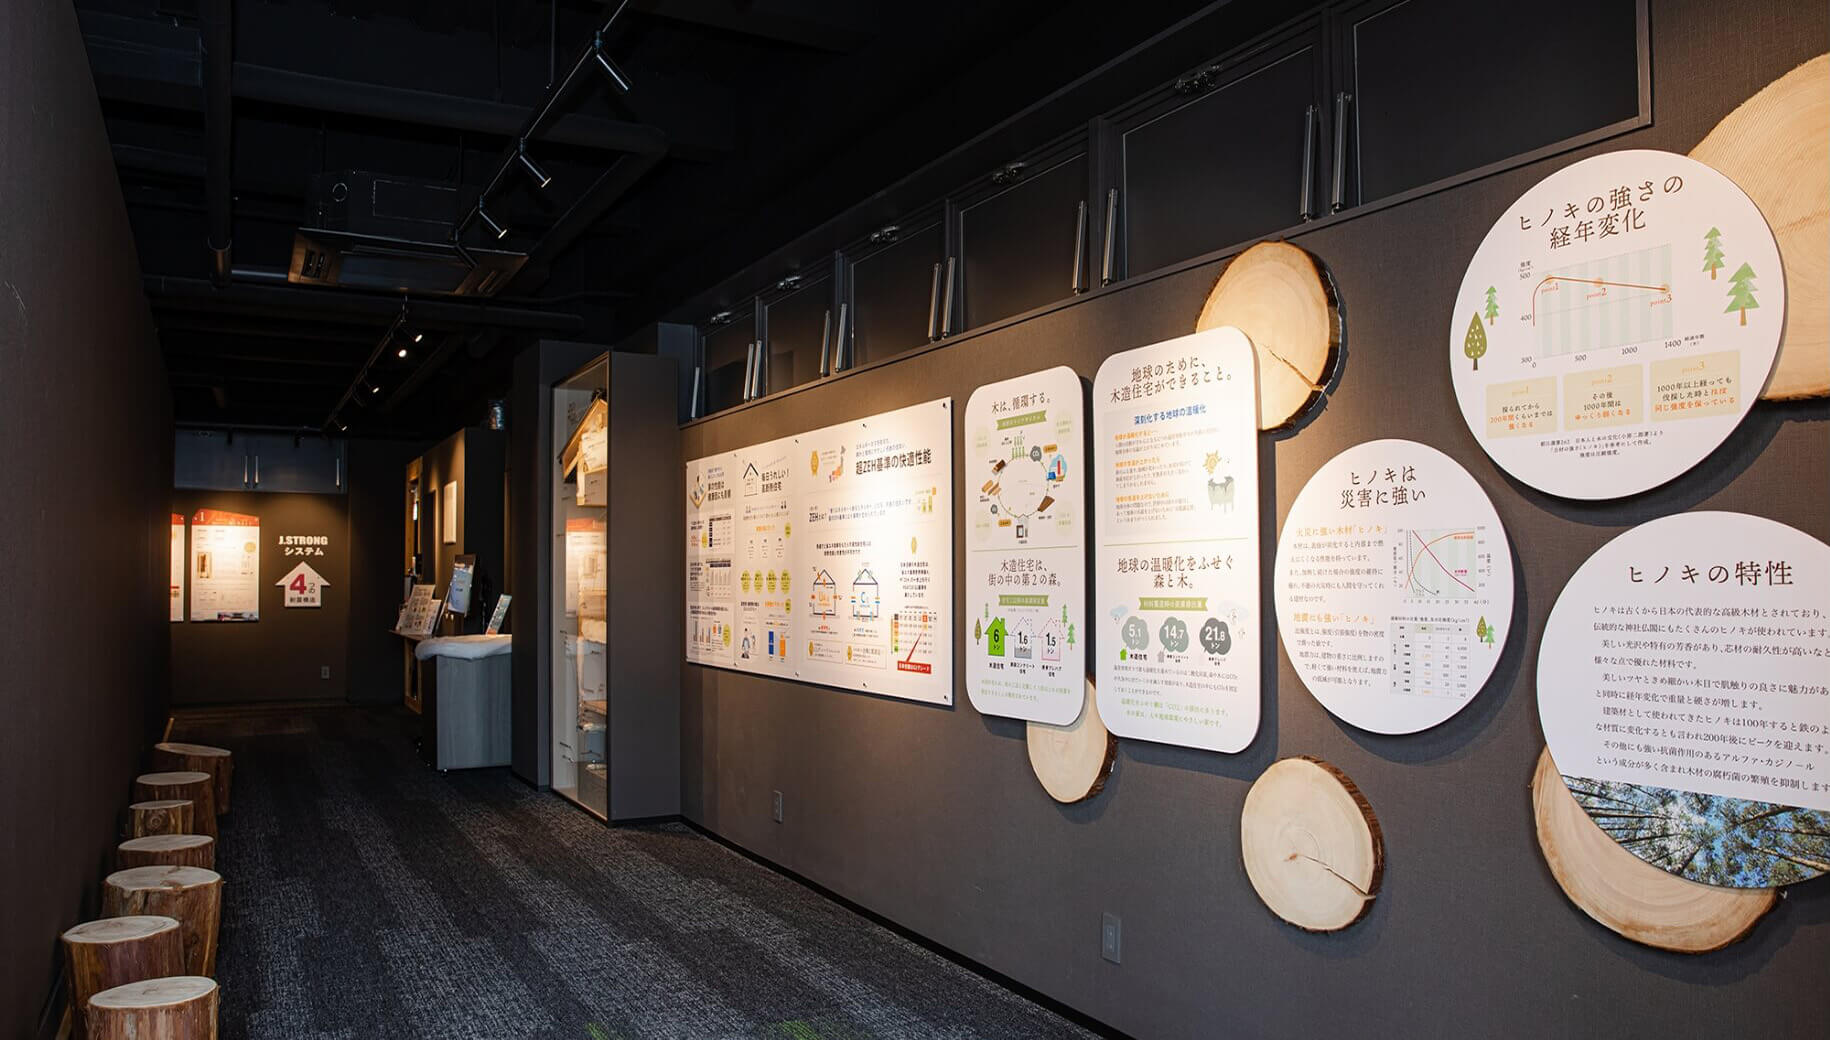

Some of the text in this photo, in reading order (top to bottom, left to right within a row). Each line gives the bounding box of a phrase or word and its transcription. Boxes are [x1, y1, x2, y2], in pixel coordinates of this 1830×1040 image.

[1519, 174, 1685, 230] ヒノキの強さの
[1549, 207, 1647, 250] 経年変化
[1520, 313, 1532, 321] 400
[1621, 346, 1638, 355] 1000
[1664, 339, 1682, 348] 1400
[1575, 354, 1587, 362] 500
[1130, 355, 1207, 383] 地球のために、
[1110, 367, 1232, 403] 木造住宅ができること。
[1657, 376, 1732, 392] 1000年以上経っても
[991, 392, 1051, 414] 木は、循環する。
[855, 448, 932, 475] 超ZEH基準の快適性能
[1350, 466, 1417, 486] ヒノキは
[1340, 485, 1426, 509] 災害に強い
[279, 535, 328, 545] J.STRONG
[284, 547, 324, 556] システム
[1000, 558, 1048, 573] 木造住宅は、
[1117, 555, 1233, 574] 地球の温暖化をふせぐ
[988, 573, 1061, 587] 街の中の第2の森。
[1629, 560, 1794, 587] ヒノキの特性
[289, 573, 307, 595] 4
[1153, 574, 1194, 590] 森と木。
[1593, 606, 1827, 619] ヒノキは古くから日本の代表的な高級木材とされており、
[993, 628, 1000, 643] 6
[1128, 623, 1142, 637] 5.1
[1163, 625, 1185, 640] 14.7
[1204, 626, 1226, 642] 21.8
[1017, 631, 1029, 645] 1.6
[1045, 631, 1057, 648] 1.5
[1170, 640, 1179, 648] トン
[993, 643, 1001, 651] トン
[1046, 647, 1055, 655] トン
[1210, 642, 1220, 650] トン
[1594, 655, 1697, 670] 様々な点で優れた材料です。
[1596, 690, 1763, 711] と同時に経年変化で重量と硬さが増します。
[1603, 706, 1829, 735] 建築材として使われてきたヒノキは100年すると鉄のよ
[1603, 740, 1815, 770] その他にも強い抗菌作用のあるアルファ・カジノール
